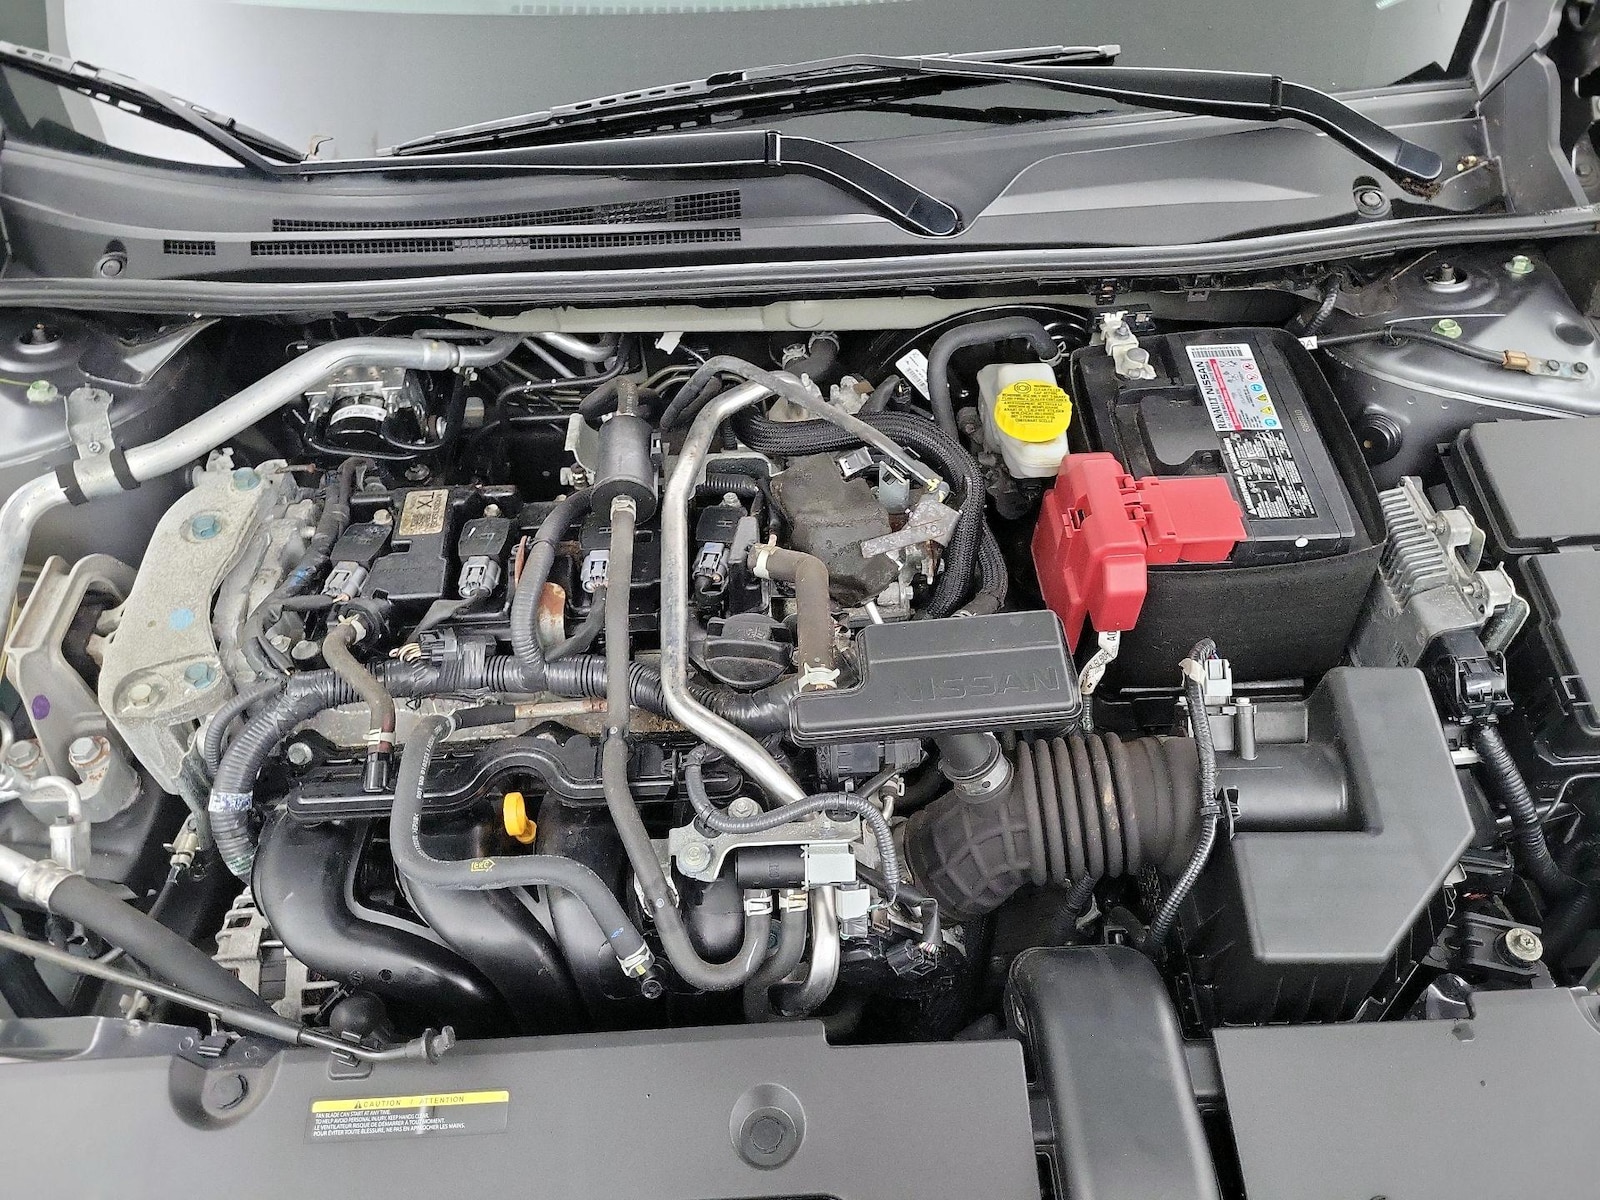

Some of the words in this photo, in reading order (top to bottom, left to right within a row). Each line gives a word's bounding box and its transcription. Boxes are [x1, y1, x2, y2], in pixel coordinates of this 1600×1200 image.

[1195, 361, 1215, 395] NISSAN
[1208, 397, 1227, 429] RENAULT
[895, 667, 1060, 704] NISSAN
[363, 1100, 402, 1108] CAUTION
[420, 1096, 464, 1104] ATTENTION
